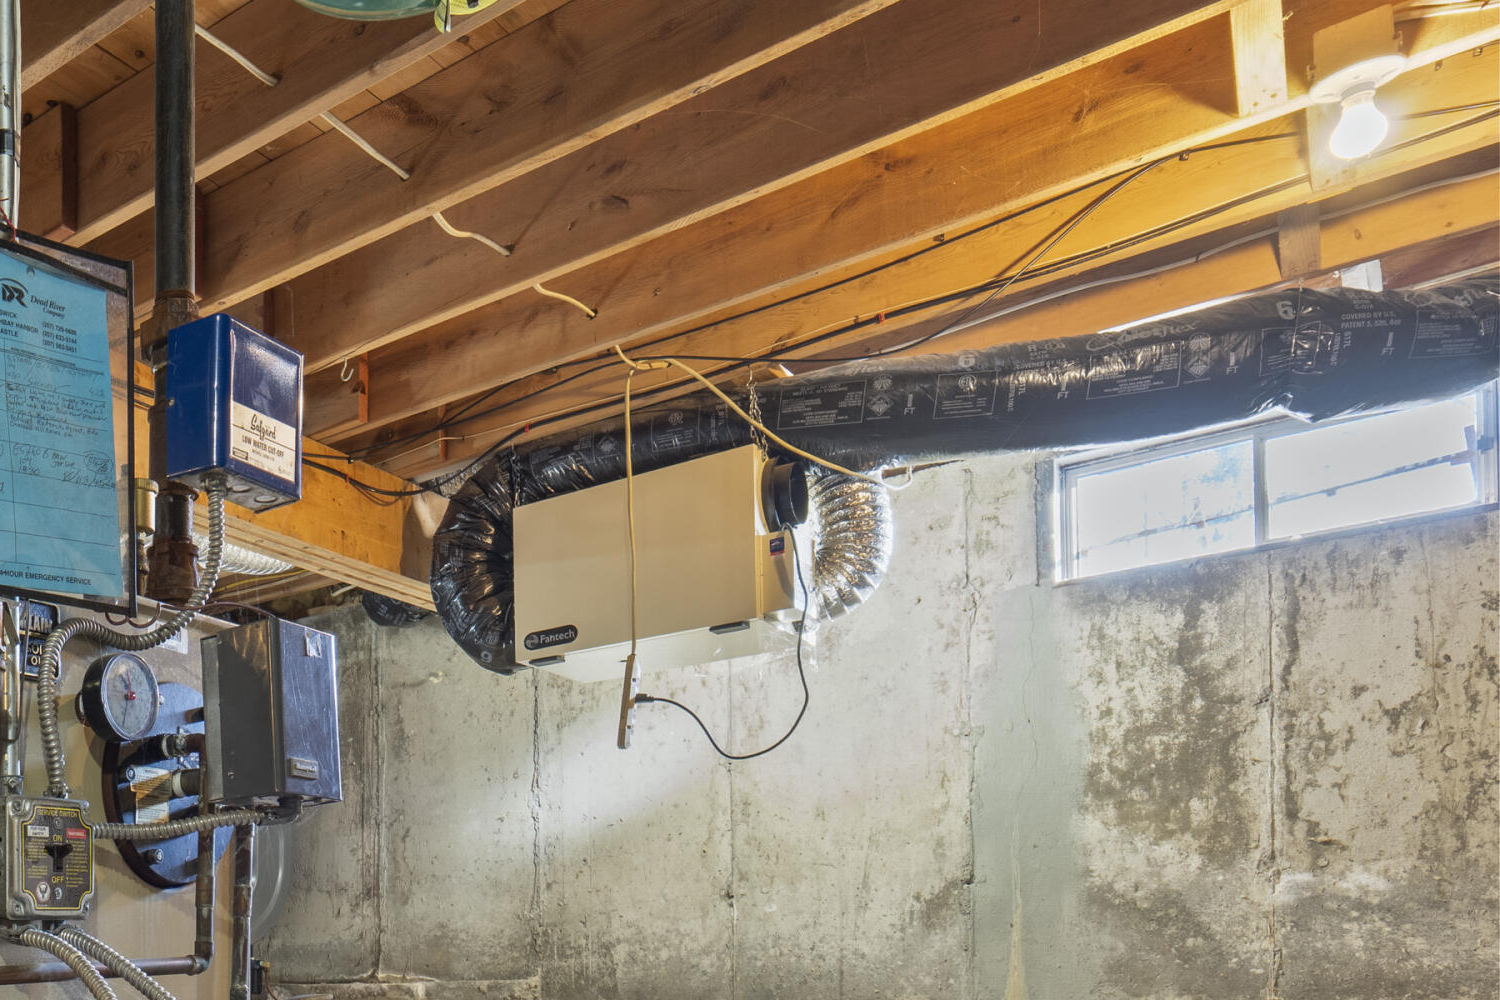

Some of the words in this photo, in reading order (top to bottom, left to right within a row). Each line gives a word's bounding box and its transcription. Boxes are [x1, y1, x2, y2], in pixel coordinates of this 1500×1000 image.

[242, 435, 252, 445] LOW
[252, 439, 268, 451] WATER
[25, 572, 64, 582] EMERGENCY
[65, 576, 92, 586] SERVICE
[540, 629, 575, 645] Fantech
[52, 834, 63, 842] ON
[51, 876, 65, 884] OFF
